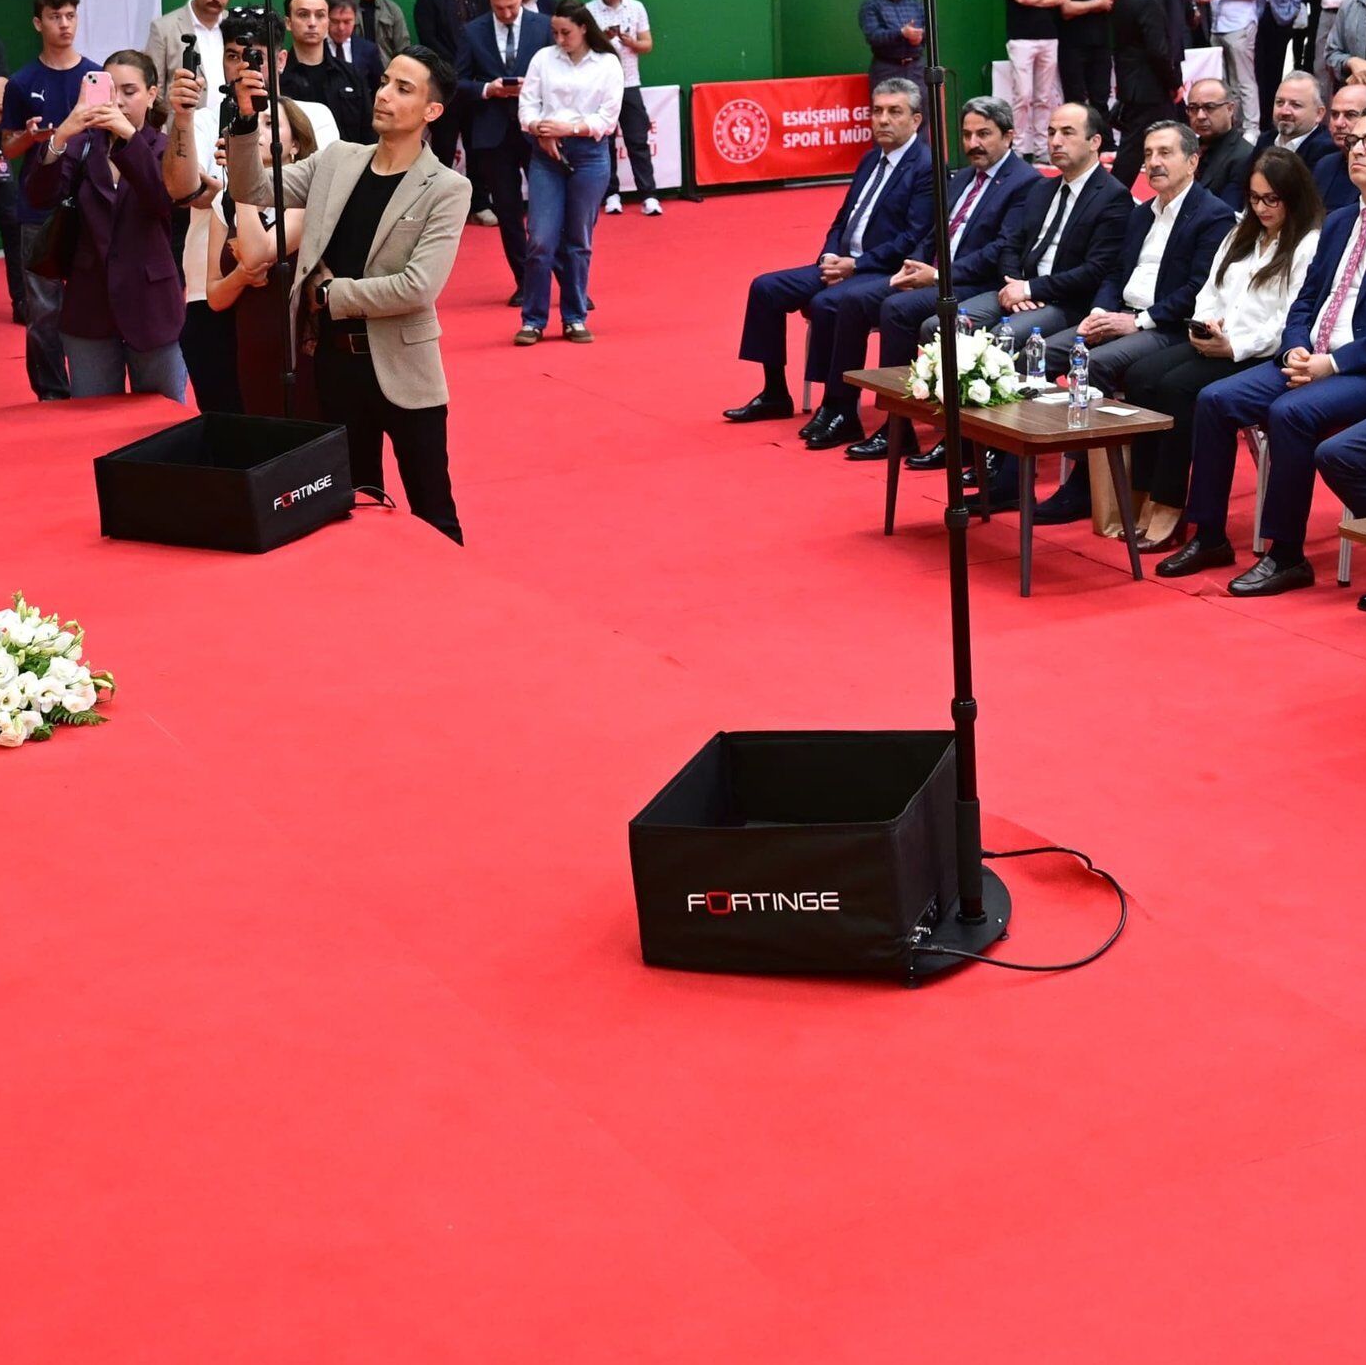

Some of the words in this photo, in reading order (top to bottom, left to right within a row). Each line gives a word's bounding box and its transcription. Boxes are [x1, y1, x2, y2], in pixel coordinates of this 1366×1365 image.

[782, 105, 850, 128] ESKİŞEHİR
[782, 130, 821, 148] SPOR
[824, 127, 837, 146] İL
[273, 474, 333, 510] FORTINGE
[687, 891, 840, 916] FORTINGE
